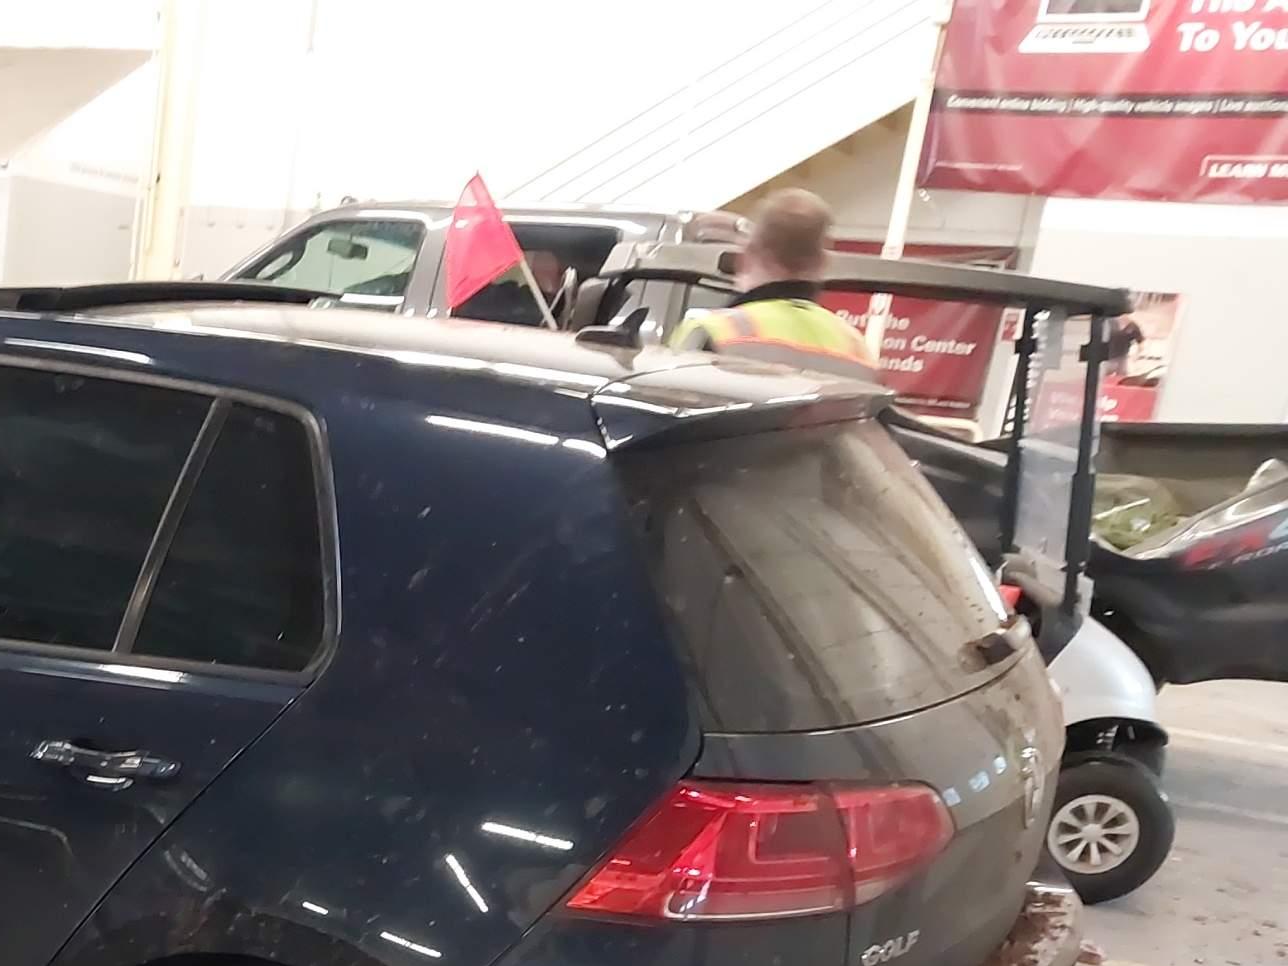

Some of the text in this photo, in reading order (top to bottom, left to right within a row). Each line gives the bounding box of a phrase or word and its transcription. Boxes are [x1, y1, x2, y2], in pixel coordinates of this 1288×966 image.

[1176, 22, 1220, 52] To
[1208, 163, 1269, 178] LEARN
[911, 335, 977, 356] Center
